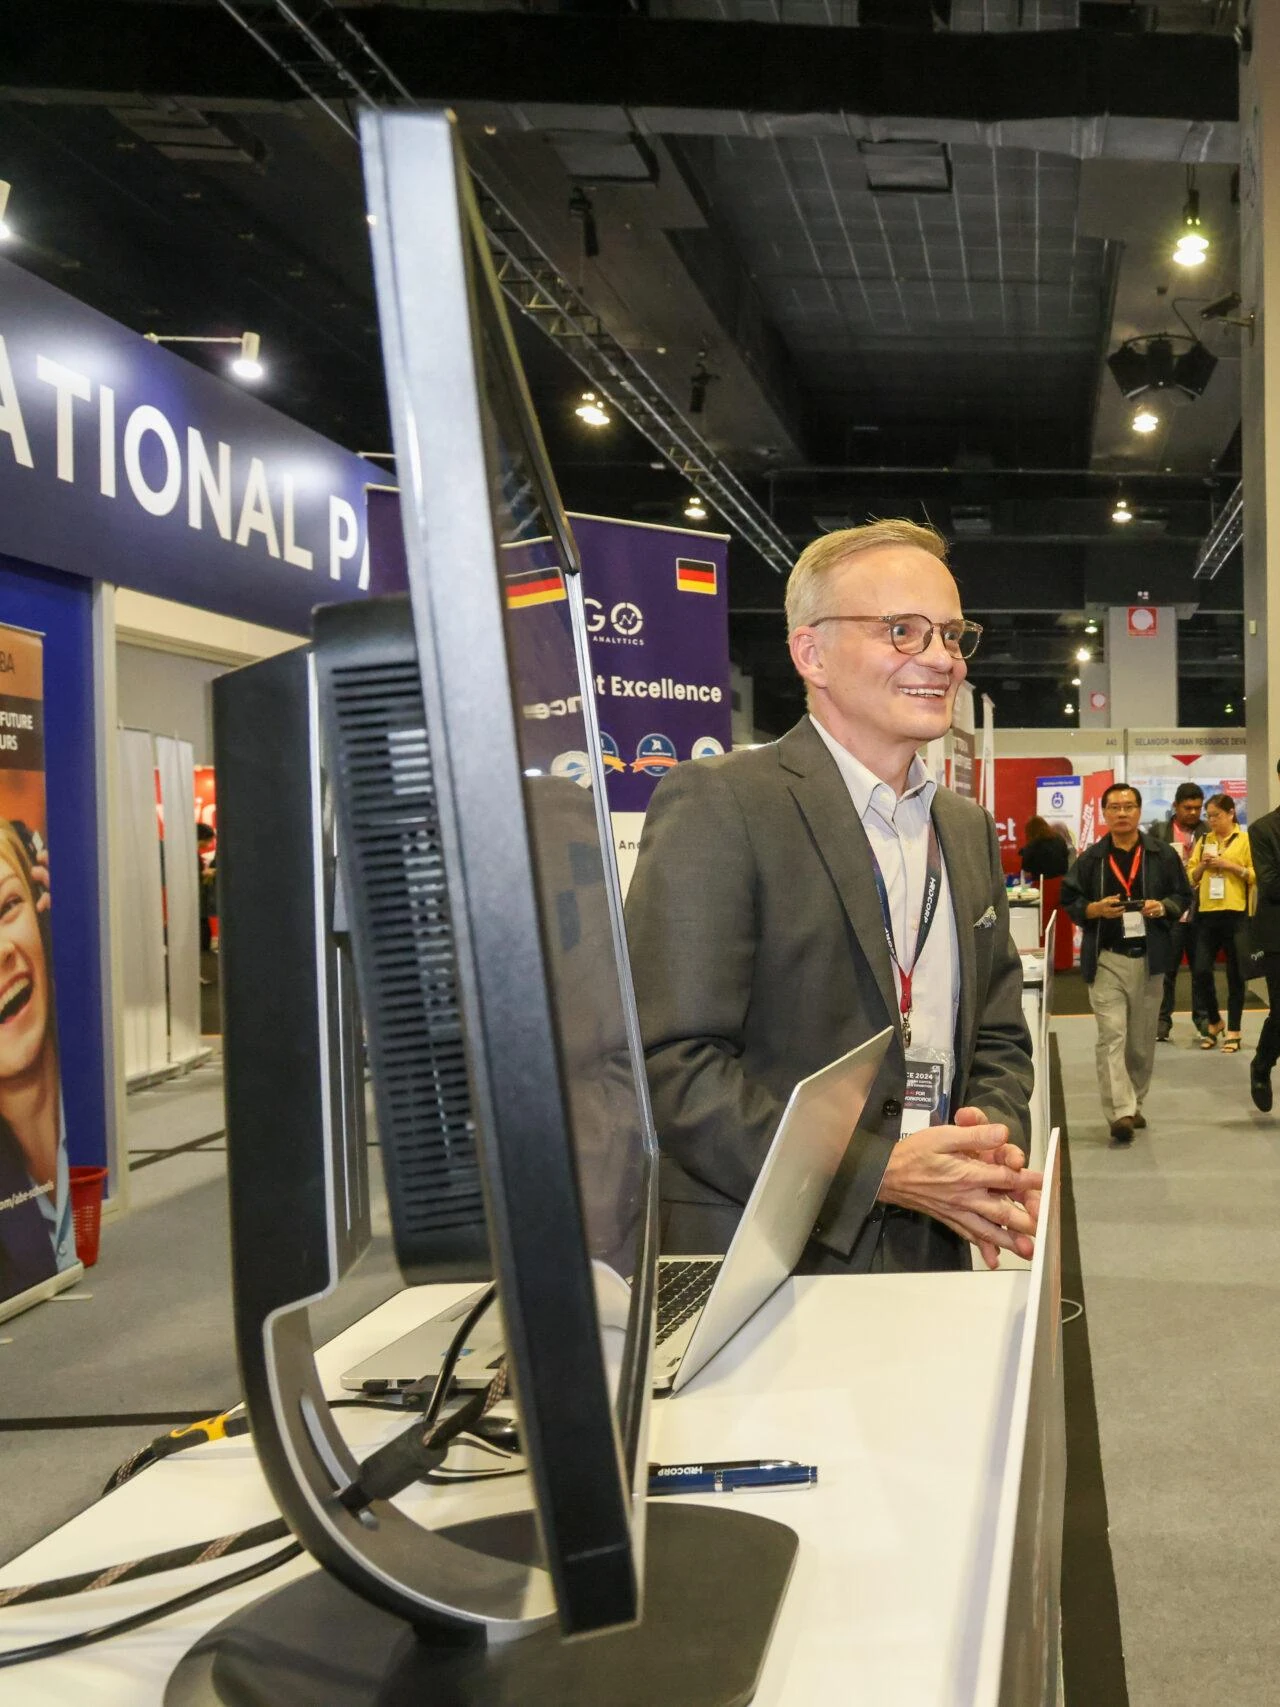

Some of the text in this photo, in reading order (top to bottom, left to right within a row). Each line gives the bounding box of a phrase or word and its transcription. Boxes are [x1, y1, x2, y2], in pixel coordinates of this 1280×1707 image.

[330, 495, 370, 591] P
[593, 635, 645, 646] ANALYTICS
[611, 676, 722, 703] Excellence
[924, 876, 937, 924] HRDCORP
[915, 1072, 933, 1080] 2024
[657, 1465, 703, 1477] HRDCORP
